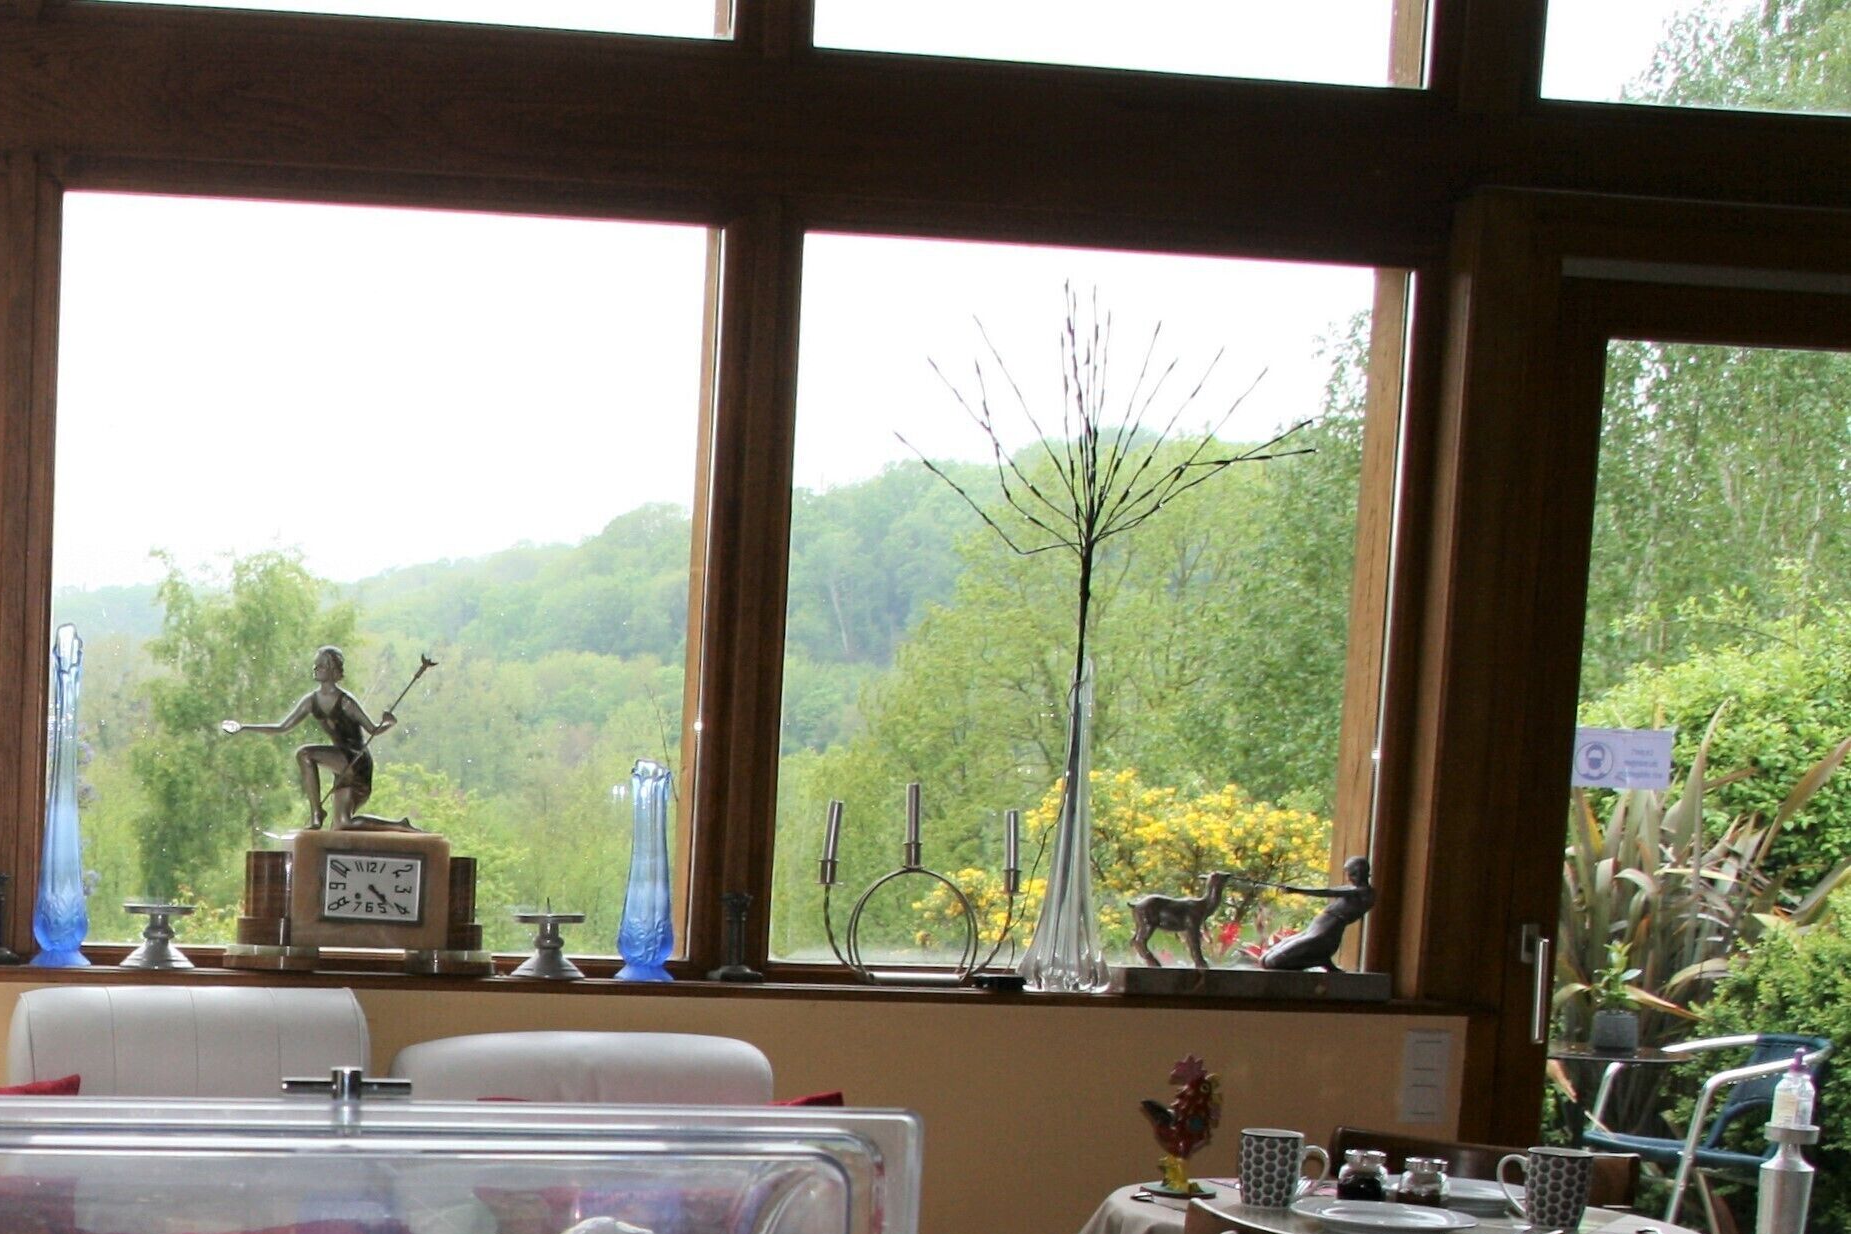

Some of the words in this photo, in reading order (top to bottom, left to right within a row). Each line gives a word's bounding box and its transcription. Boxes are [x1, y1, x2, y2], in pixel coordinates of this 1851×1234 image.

[366, 862, 378, 872] 12
[392, 864, 414, 878] 2
[329, 882, 346, 890] 9
[394, 885, 413, 894] 3
[327, 896, 350, 911] 8
[352, 901, 363, 913] 7
[365, 901, 374, 913] 6
[377, 902, 387, 914] 5
[393, 902, 410, 914] 4
